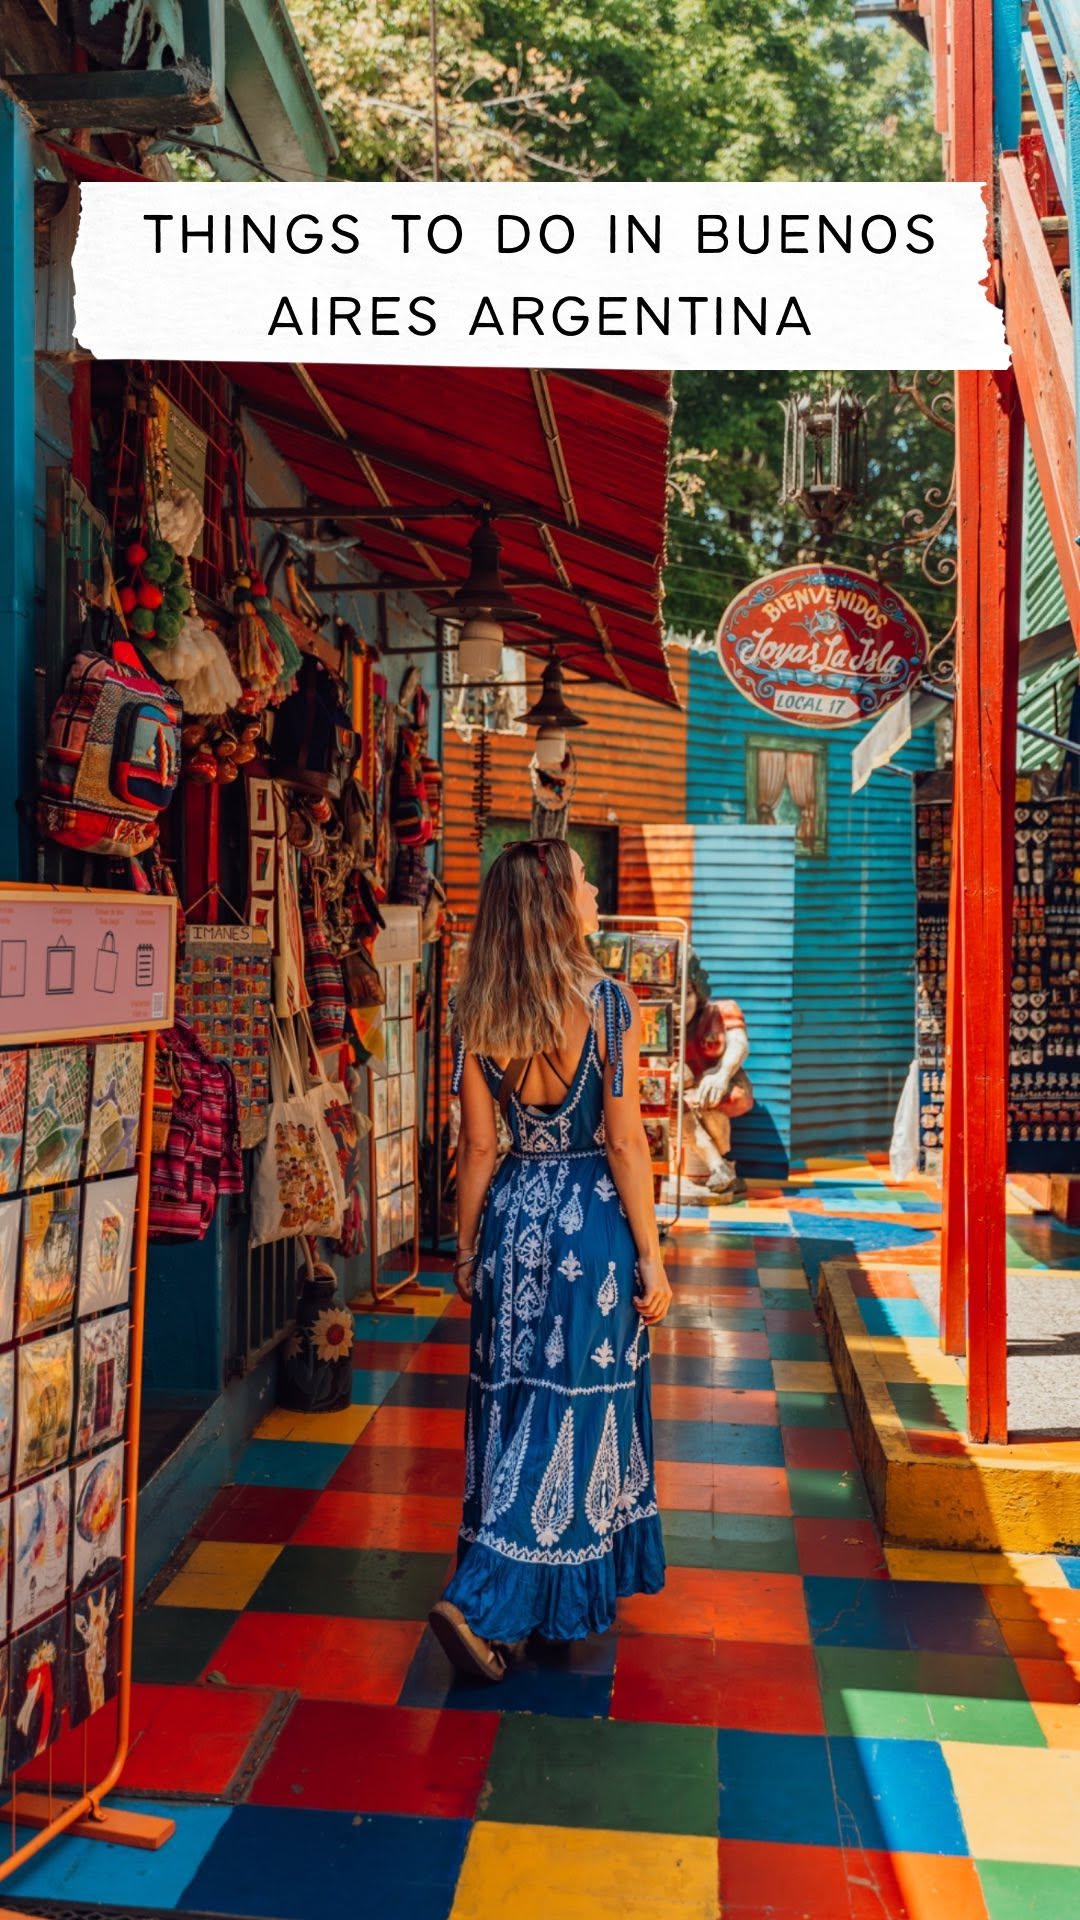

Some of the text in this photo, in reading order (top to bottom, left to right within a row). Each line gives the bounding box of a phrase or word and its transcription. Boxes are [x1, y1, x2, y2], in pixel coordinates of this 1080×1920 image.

[761, 585, 888, 630] BIENVENIDOS
[739, 627, 819, 669] Joyas
[810, 634, 850, 672] La
[776, 694, 846, 714] LOCAL 17
[192, 926, 250, 941] IMANES
